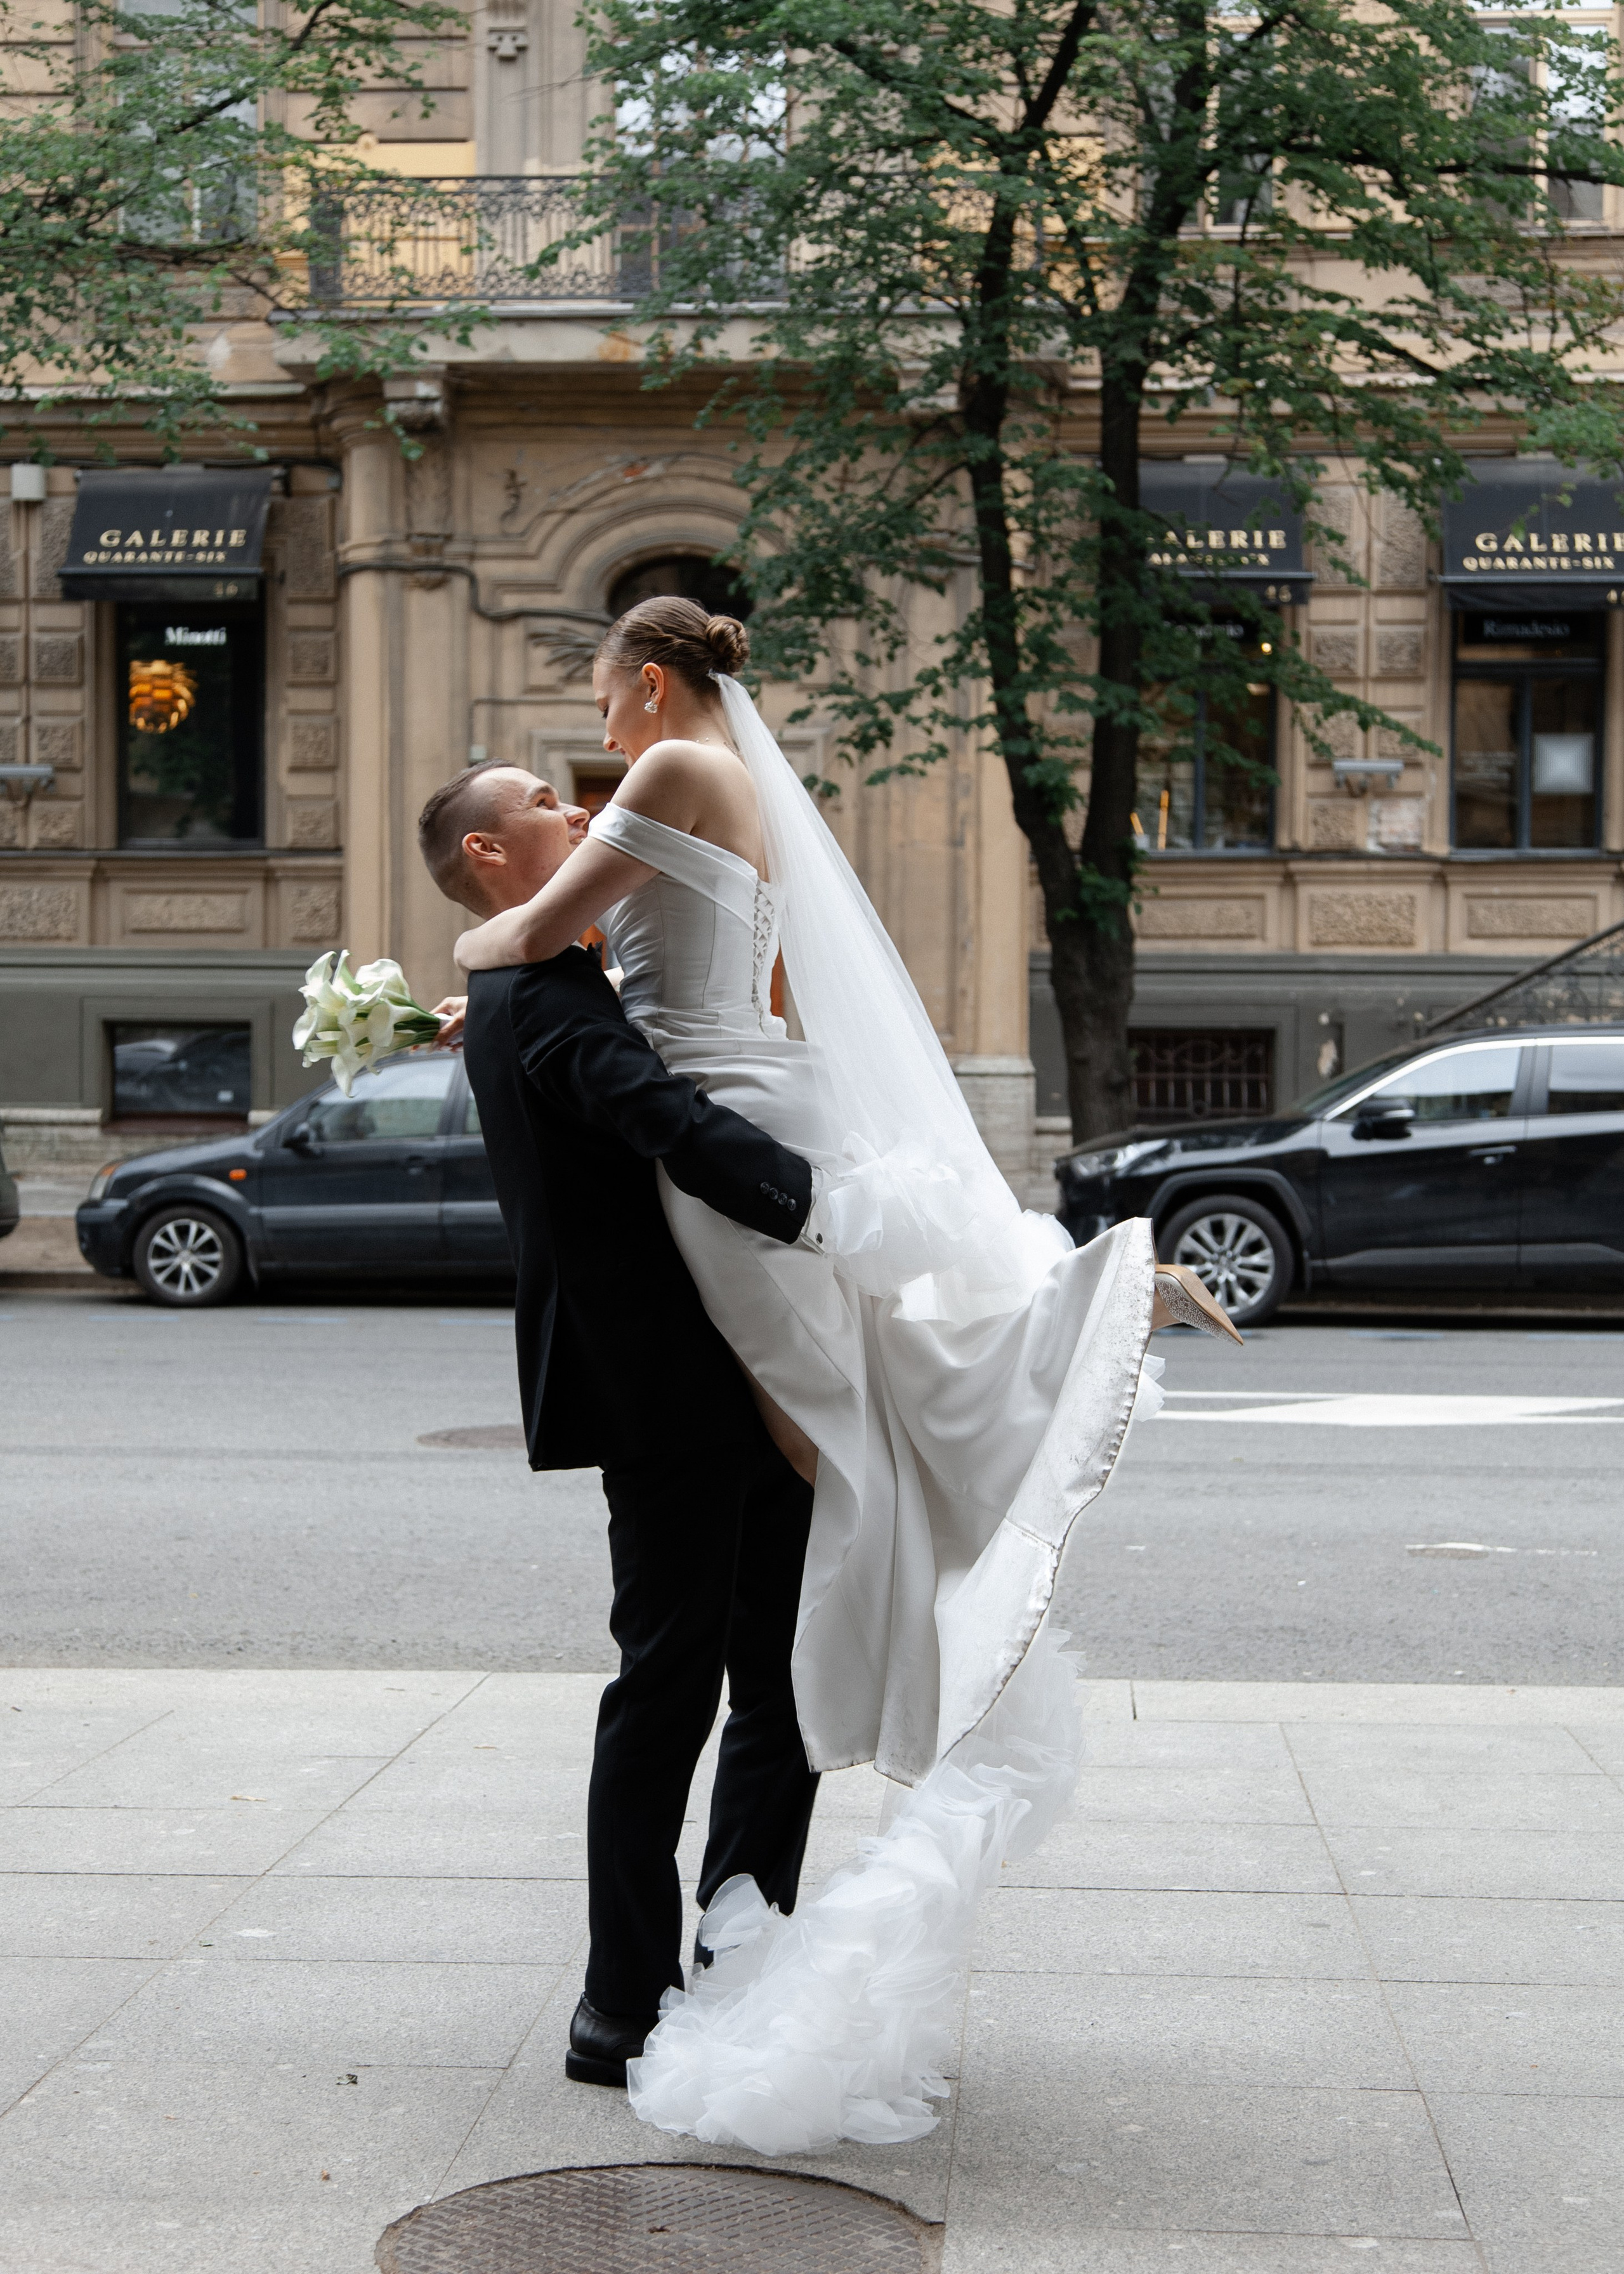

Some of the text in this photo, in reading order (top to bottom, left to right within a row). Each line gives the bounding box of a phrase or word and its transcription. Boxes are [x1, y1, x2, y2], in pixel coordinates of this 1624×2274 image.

[100, 529, 247, 547] GALERIE
[1146, 530, 1287, 549] ALERIE
[82, 551, 226, 564] QUARANTE-SIX
[1462, 556, 1616, 572] QUARANTE-SIX
[1265, 584, 1292, 603] 46
[164, 627, 226, 646] Minotti
